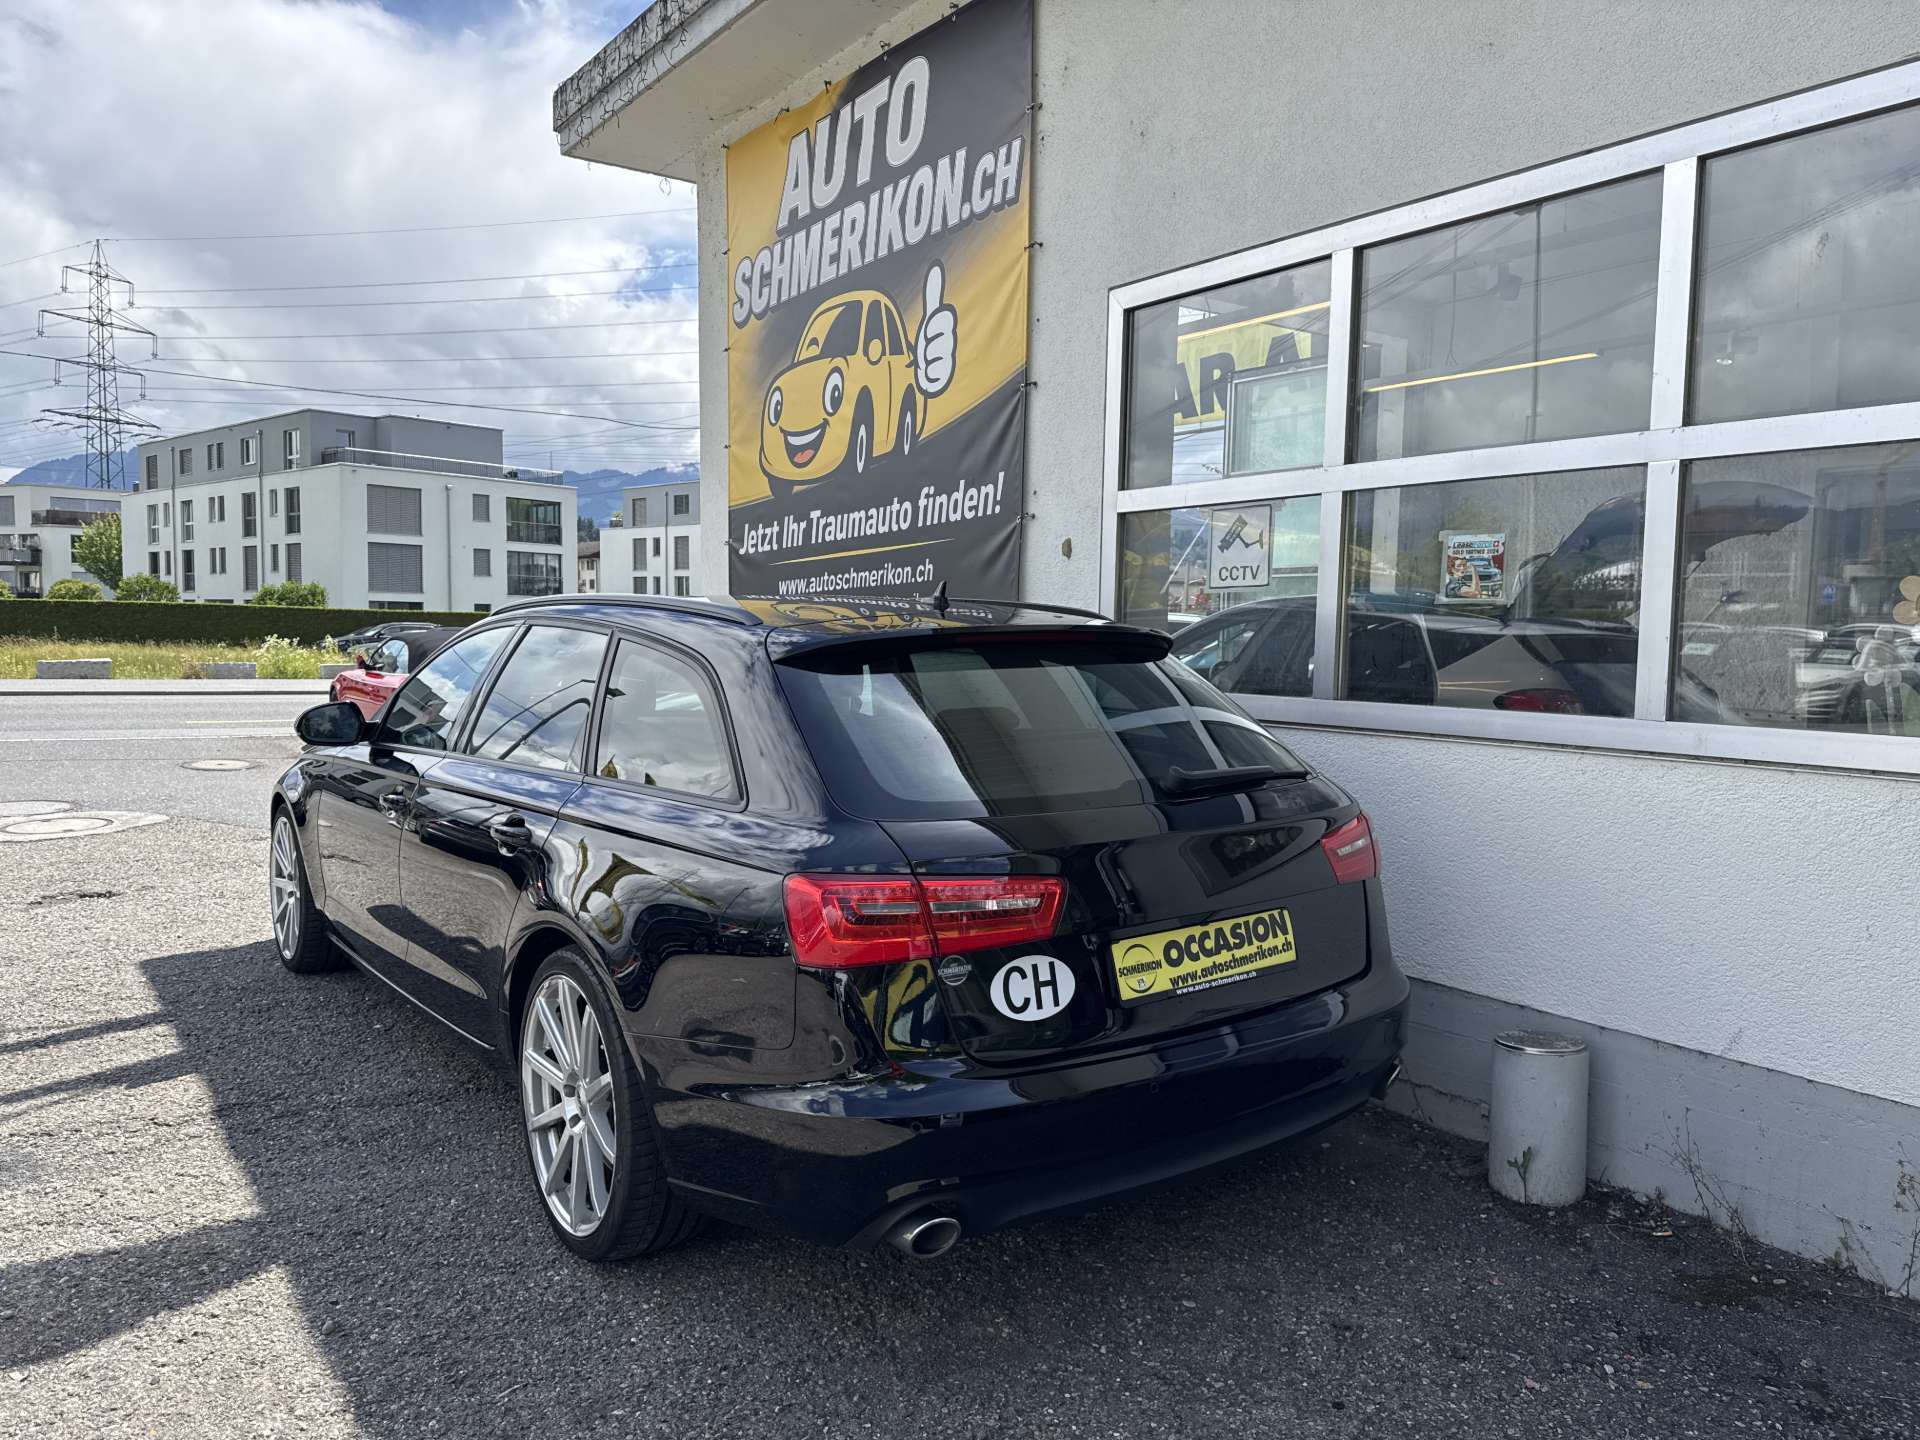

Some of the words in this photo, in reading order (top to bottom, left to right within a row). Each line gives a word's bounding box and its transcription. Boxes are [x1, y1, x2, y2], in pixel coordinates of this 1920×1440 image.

[777, 56, 930, 231] AUTO
[733, 136, 1024, 325] SCHMERIKON.CH
[739, 521, 780, 555] Jetzt
[782, 516, 807, 548] Ihr
[810, 498, 912, 545] Traumauto
[918, 472, 1004, 528] finden!
[778, 558, 933, 595] www.autoschmerikon.ch
[1218, 564, 1260, 581] CCTV
[1163, 909, 1289, 968] OCCASION
[1169, 937, 1293, 988] www.autoschmerikon.ch
[1003, 961, 1060, 1014] CH
[1118, 959, 1162, 978] SCHMERIKON
[1176, 971, 1257, 995] www.auto-schmerikon.ch
